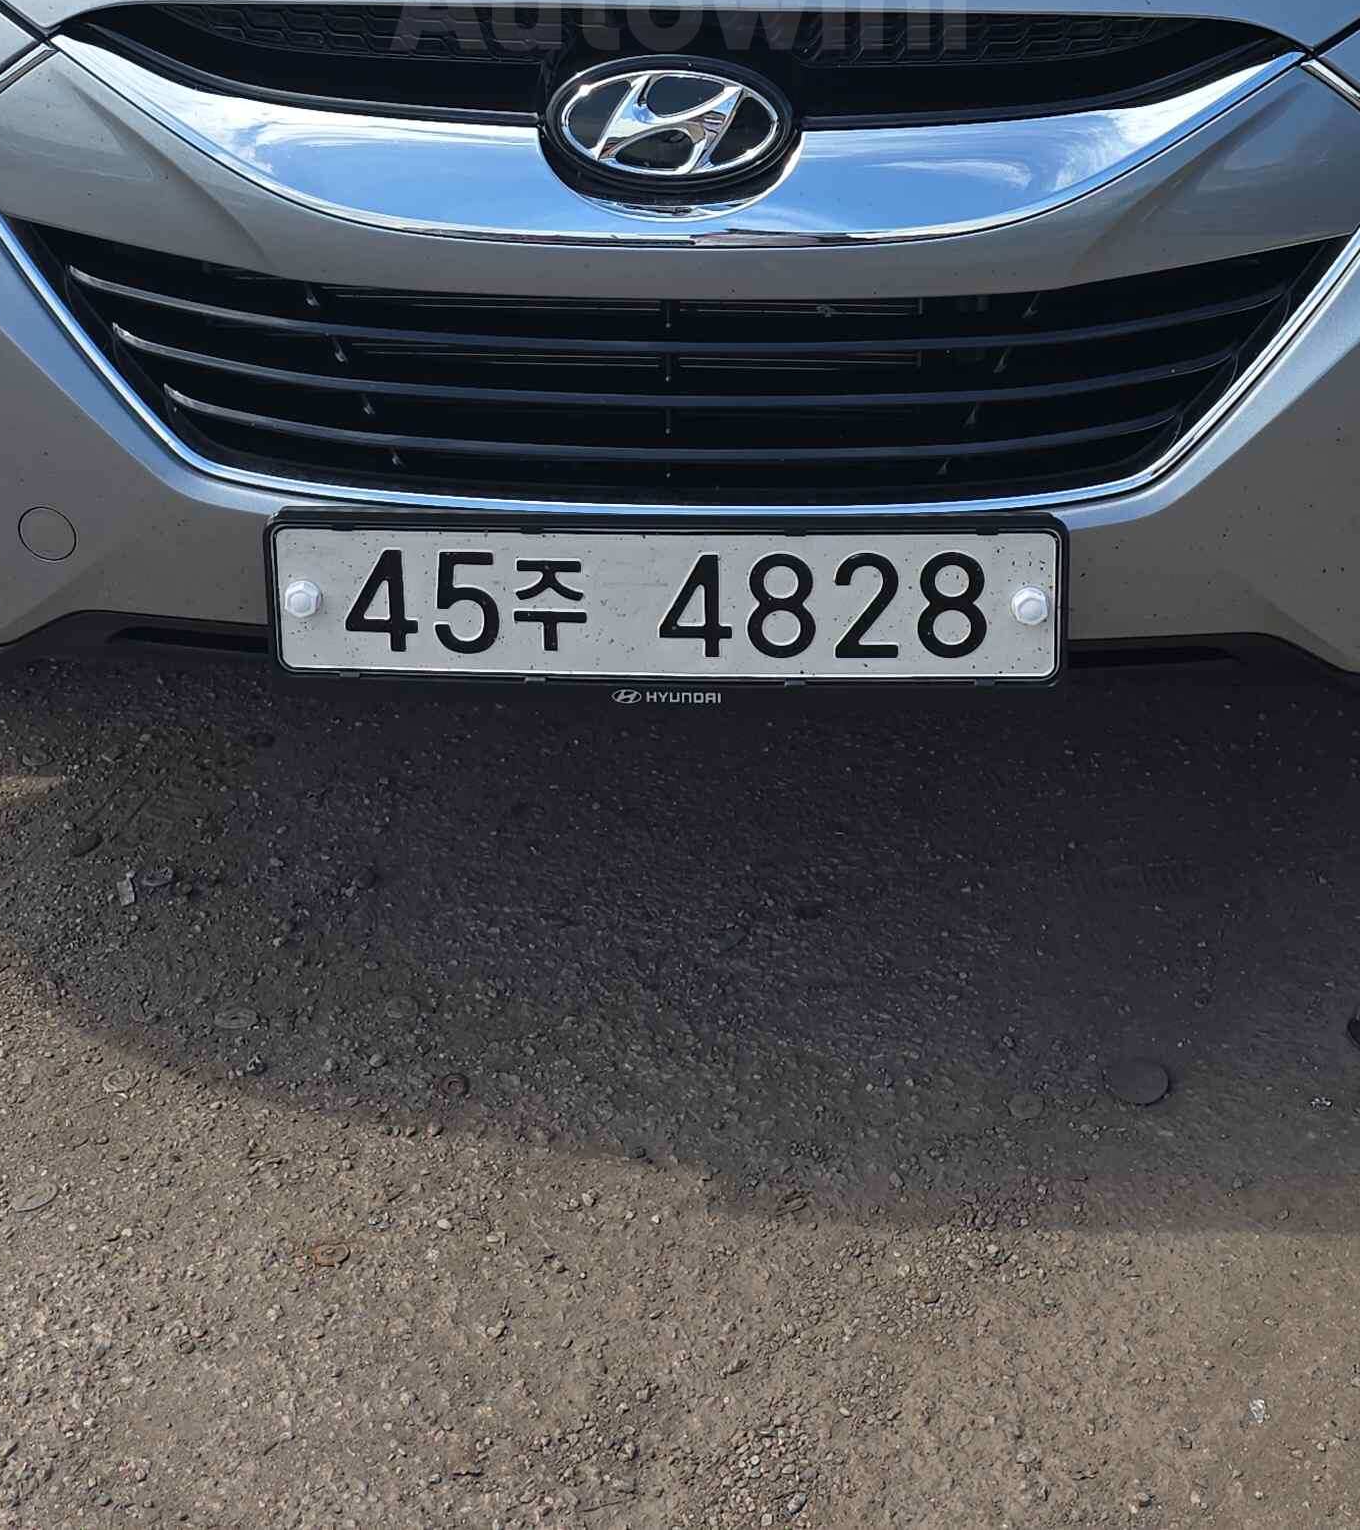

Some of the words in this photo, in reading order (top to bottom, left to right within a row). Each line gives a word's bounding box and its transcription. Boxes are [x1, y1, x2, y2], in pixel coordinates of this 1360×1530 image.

[343, 549, 589, 656] 45주
[658, 552, 989, 660] 4828
[646, 690, 722, 704] HYUNDAI
